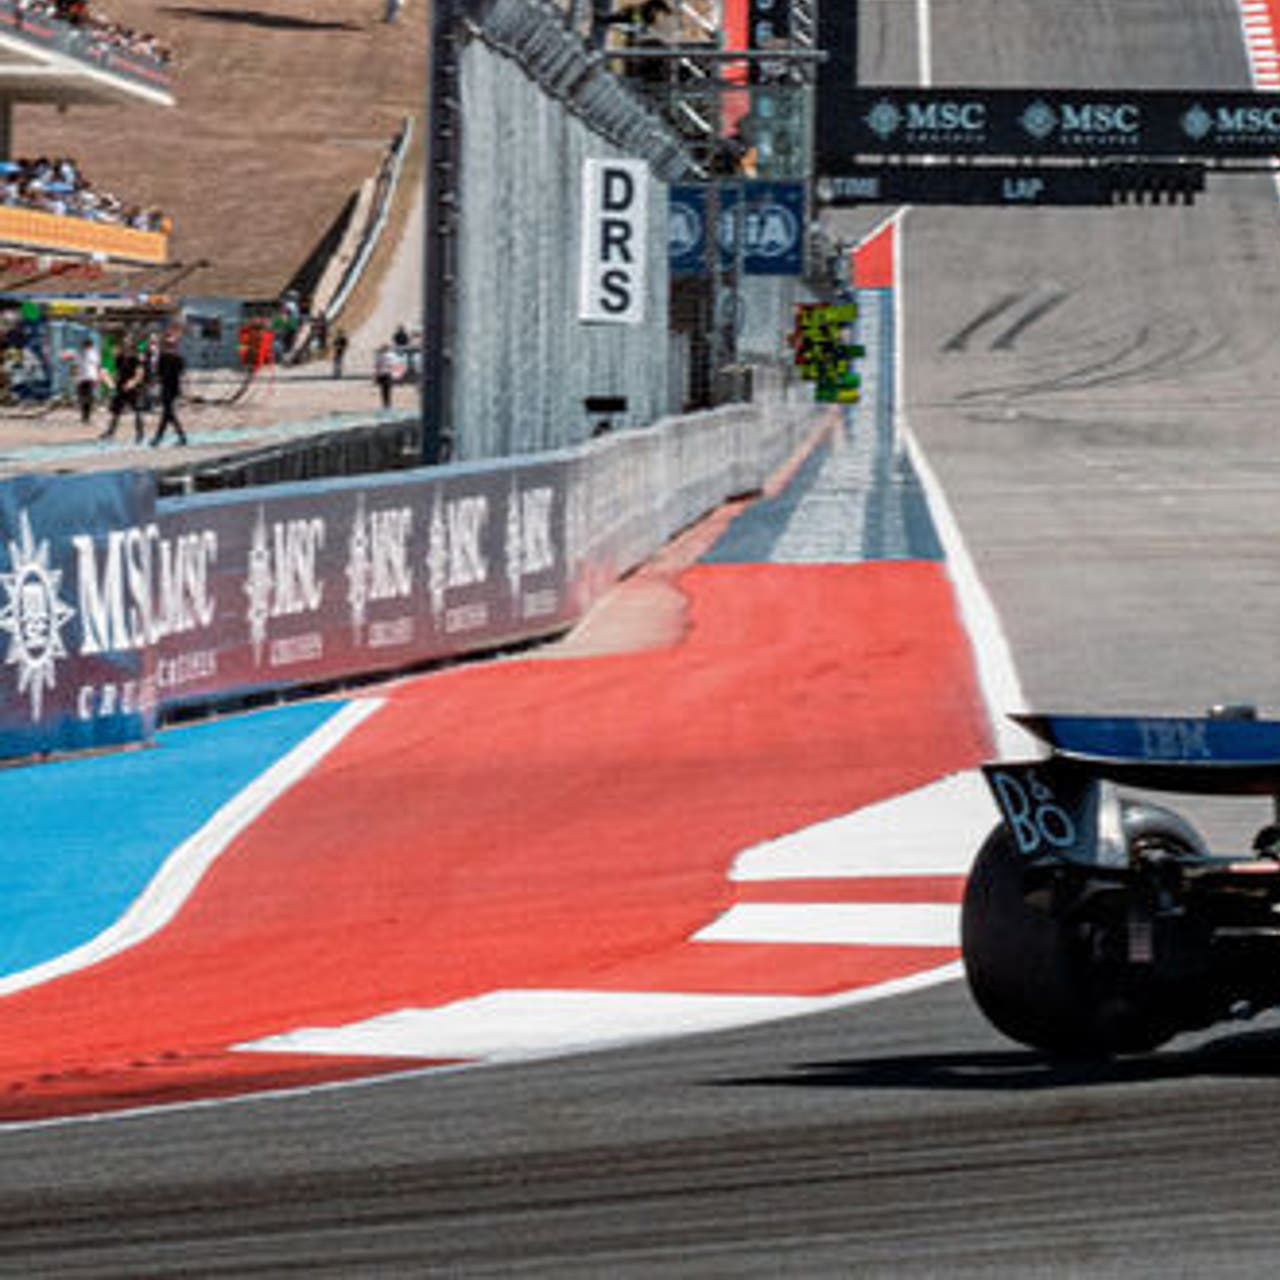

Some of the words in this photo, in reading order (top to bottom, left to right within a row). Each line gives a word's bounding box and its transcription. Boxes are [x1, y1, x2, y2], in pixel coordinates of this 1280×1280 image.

[906, 103, 987, 130] MSC
[1061, 105, 1140, 132] MSC
[1003, 177, 1045, 199] LAP
[600, 168, 634, 314] DRS
